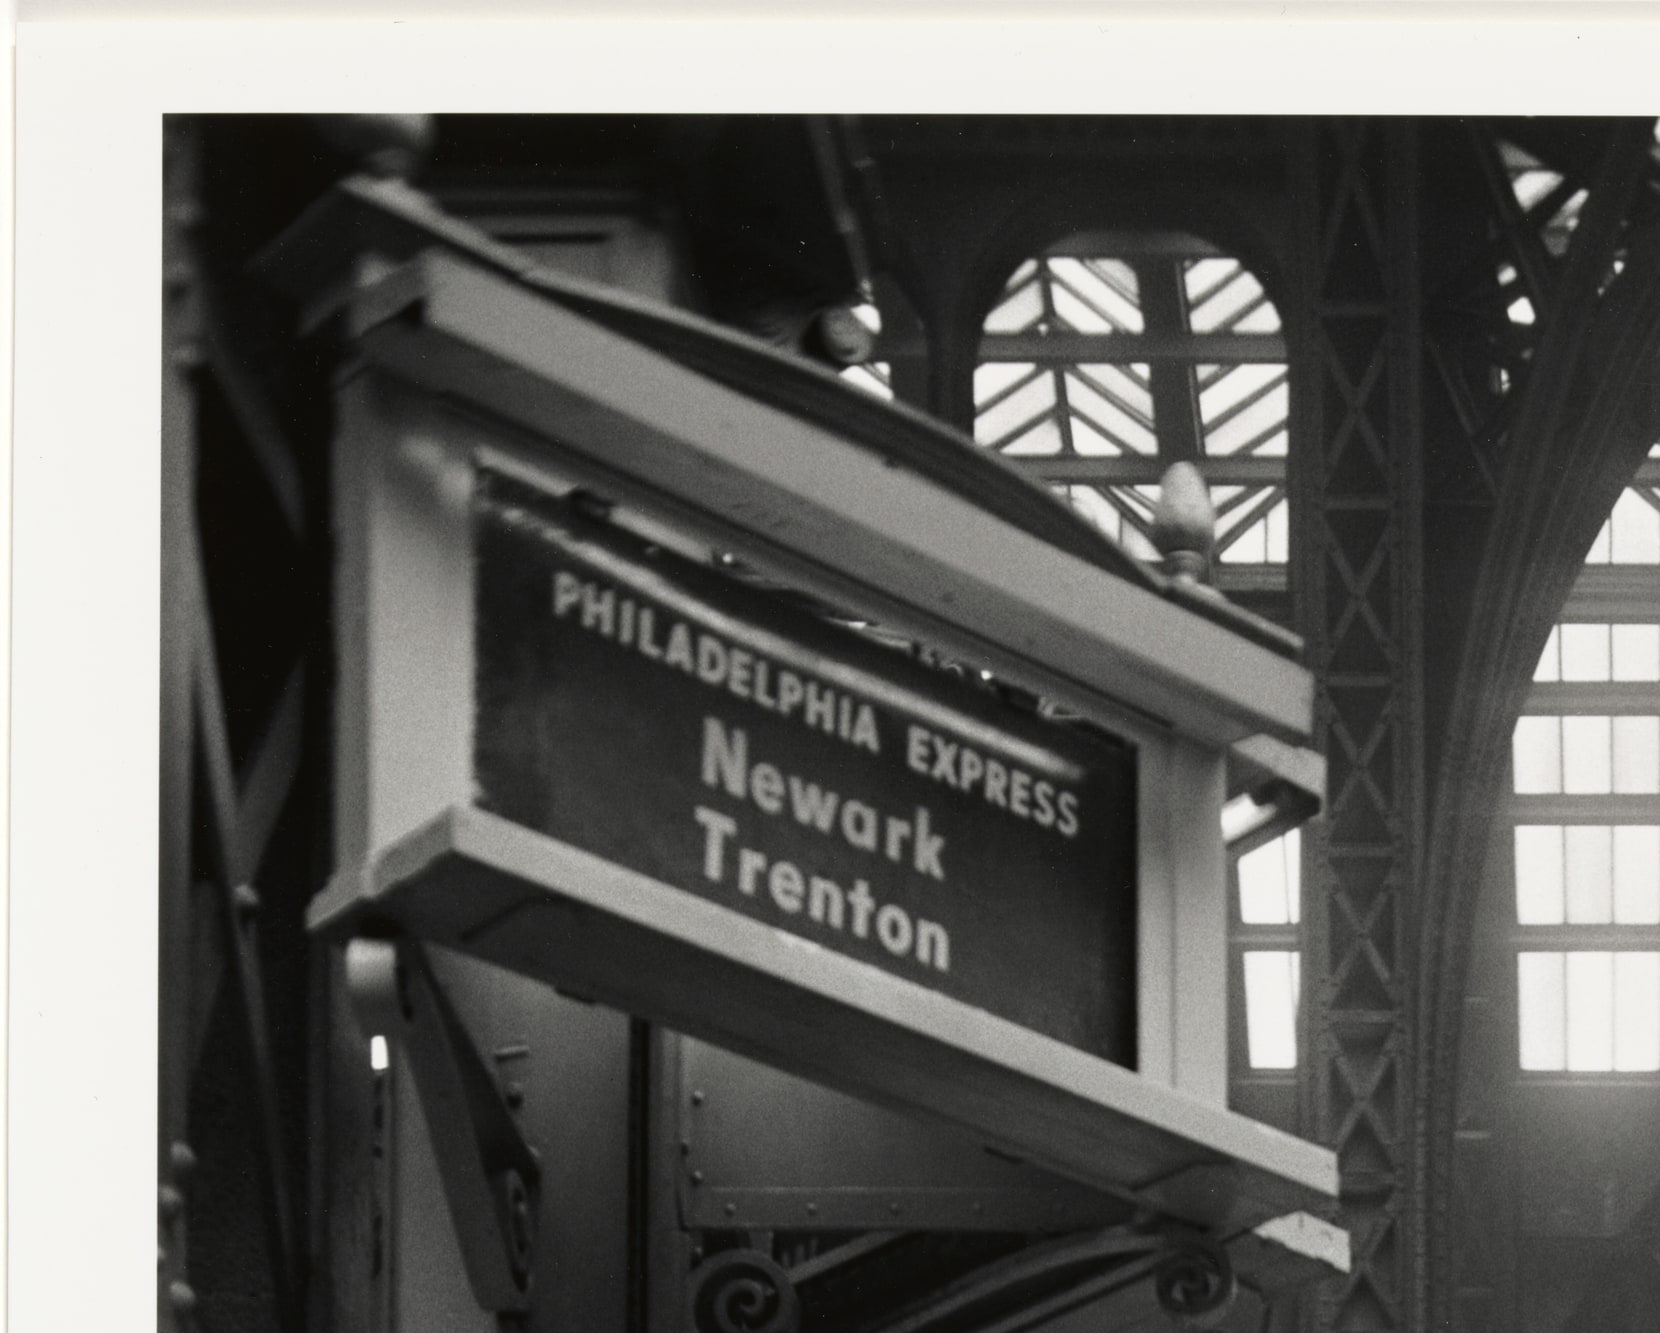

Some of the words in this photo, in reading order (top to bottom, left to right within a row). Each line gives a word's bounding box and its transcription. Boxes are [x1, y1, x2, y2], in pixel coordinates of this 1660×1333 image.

[553, 571, 880, 755] PHILADELPHIA
[906, 725, 1079, 838] EXPRESS
[702, 715, 945, 880] Newark
[694, 805, 950, 972] Trenton
